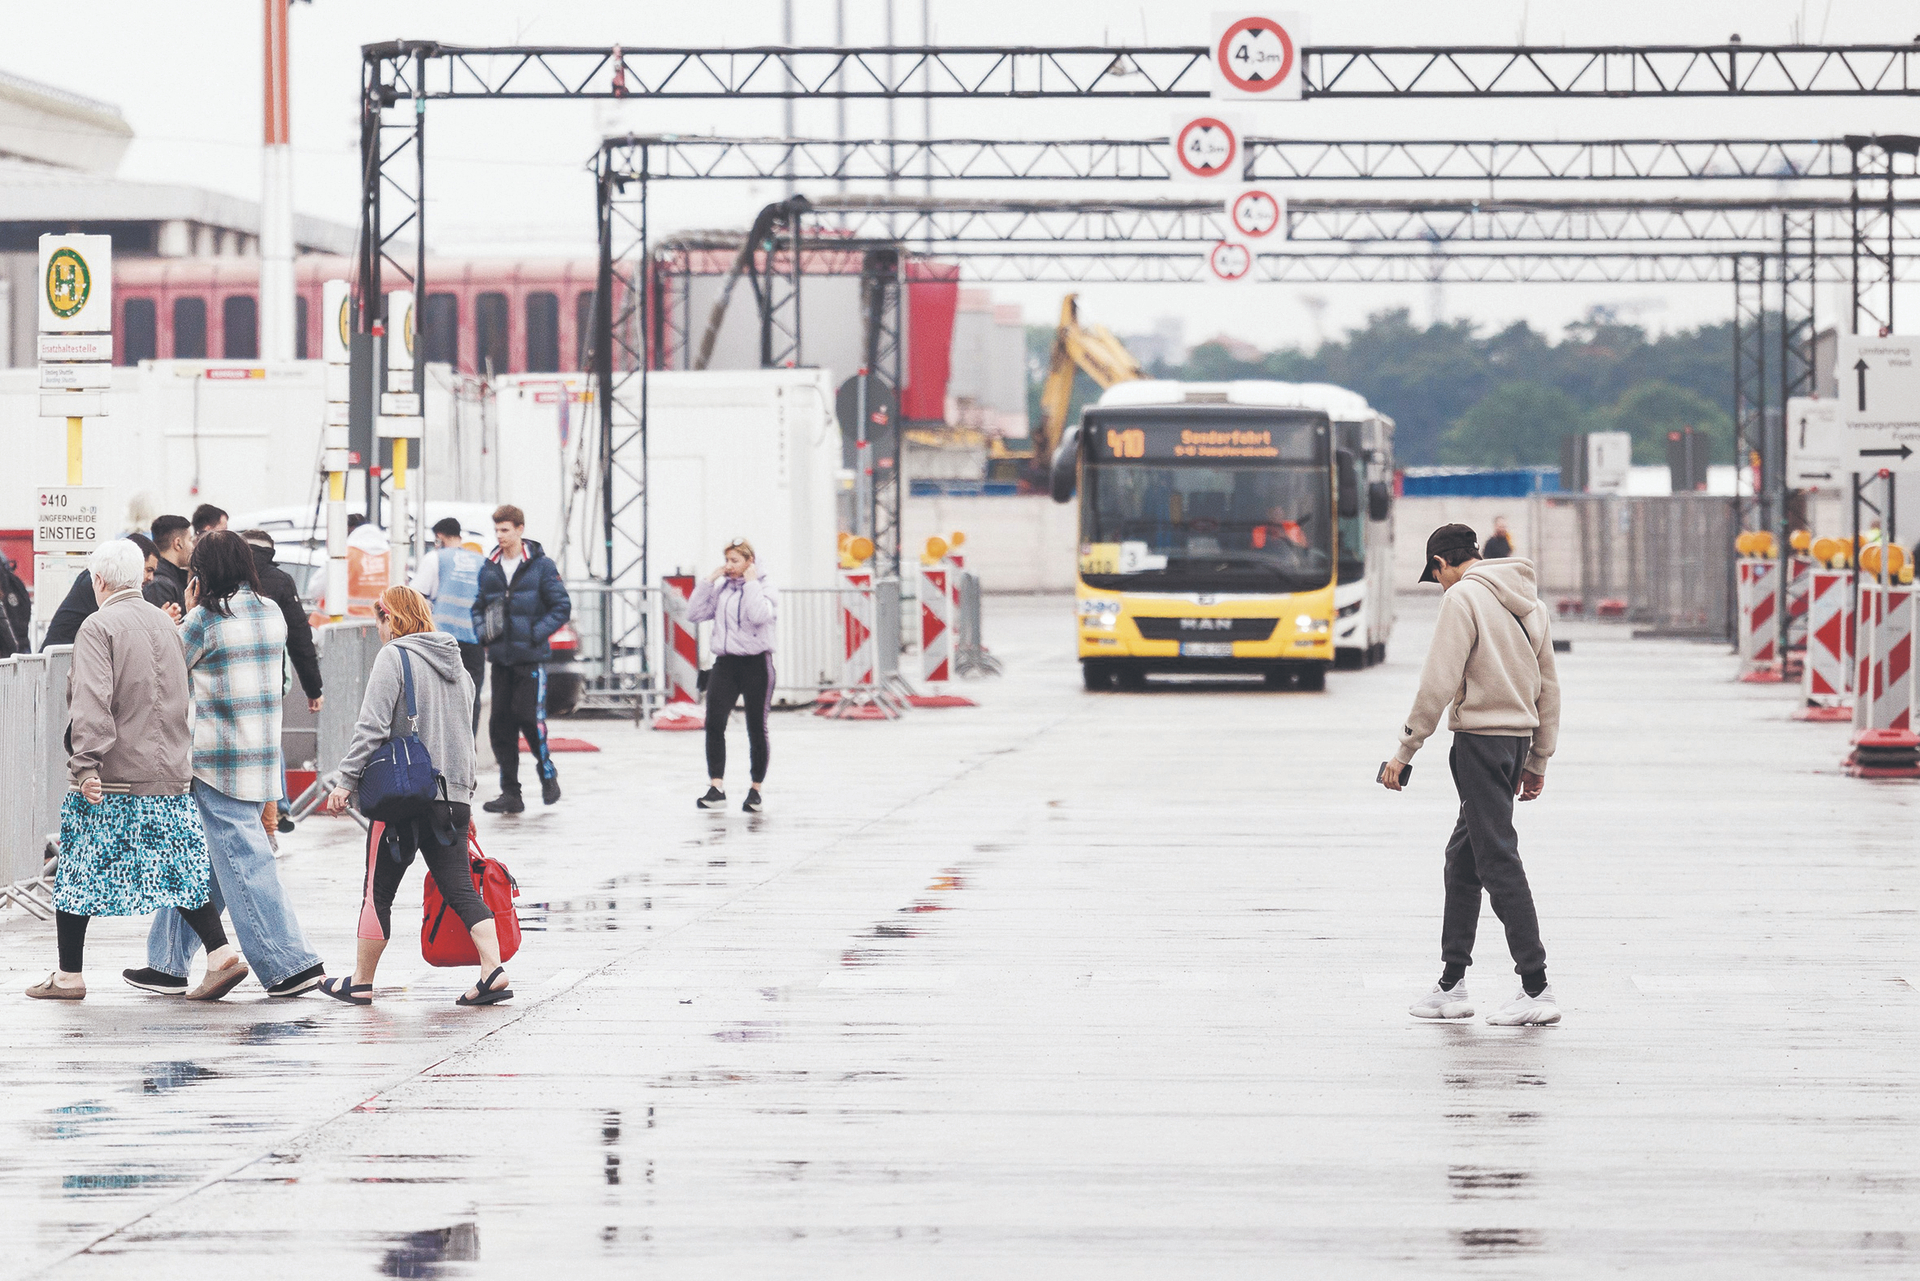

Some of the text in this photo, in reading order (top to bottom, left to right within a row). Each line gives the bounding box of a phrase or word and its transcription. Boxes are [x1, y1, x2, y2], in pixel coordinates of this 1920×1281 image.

[1235, 45, 1280, 64] 4,3m
[55, 264, 76, 302] H
[41, 344, 98, 354] Ersatzhaltestelle
[1107, 429, 1272, 459] 410 Sonderfahrt
[48, 494, 68, 507] 410
[39, 515, 97, 523] JUNGFERNHEIDE
[40, 526, 97, 540] EINSTIEG
[1180, 618, 1233, 630] MAN
